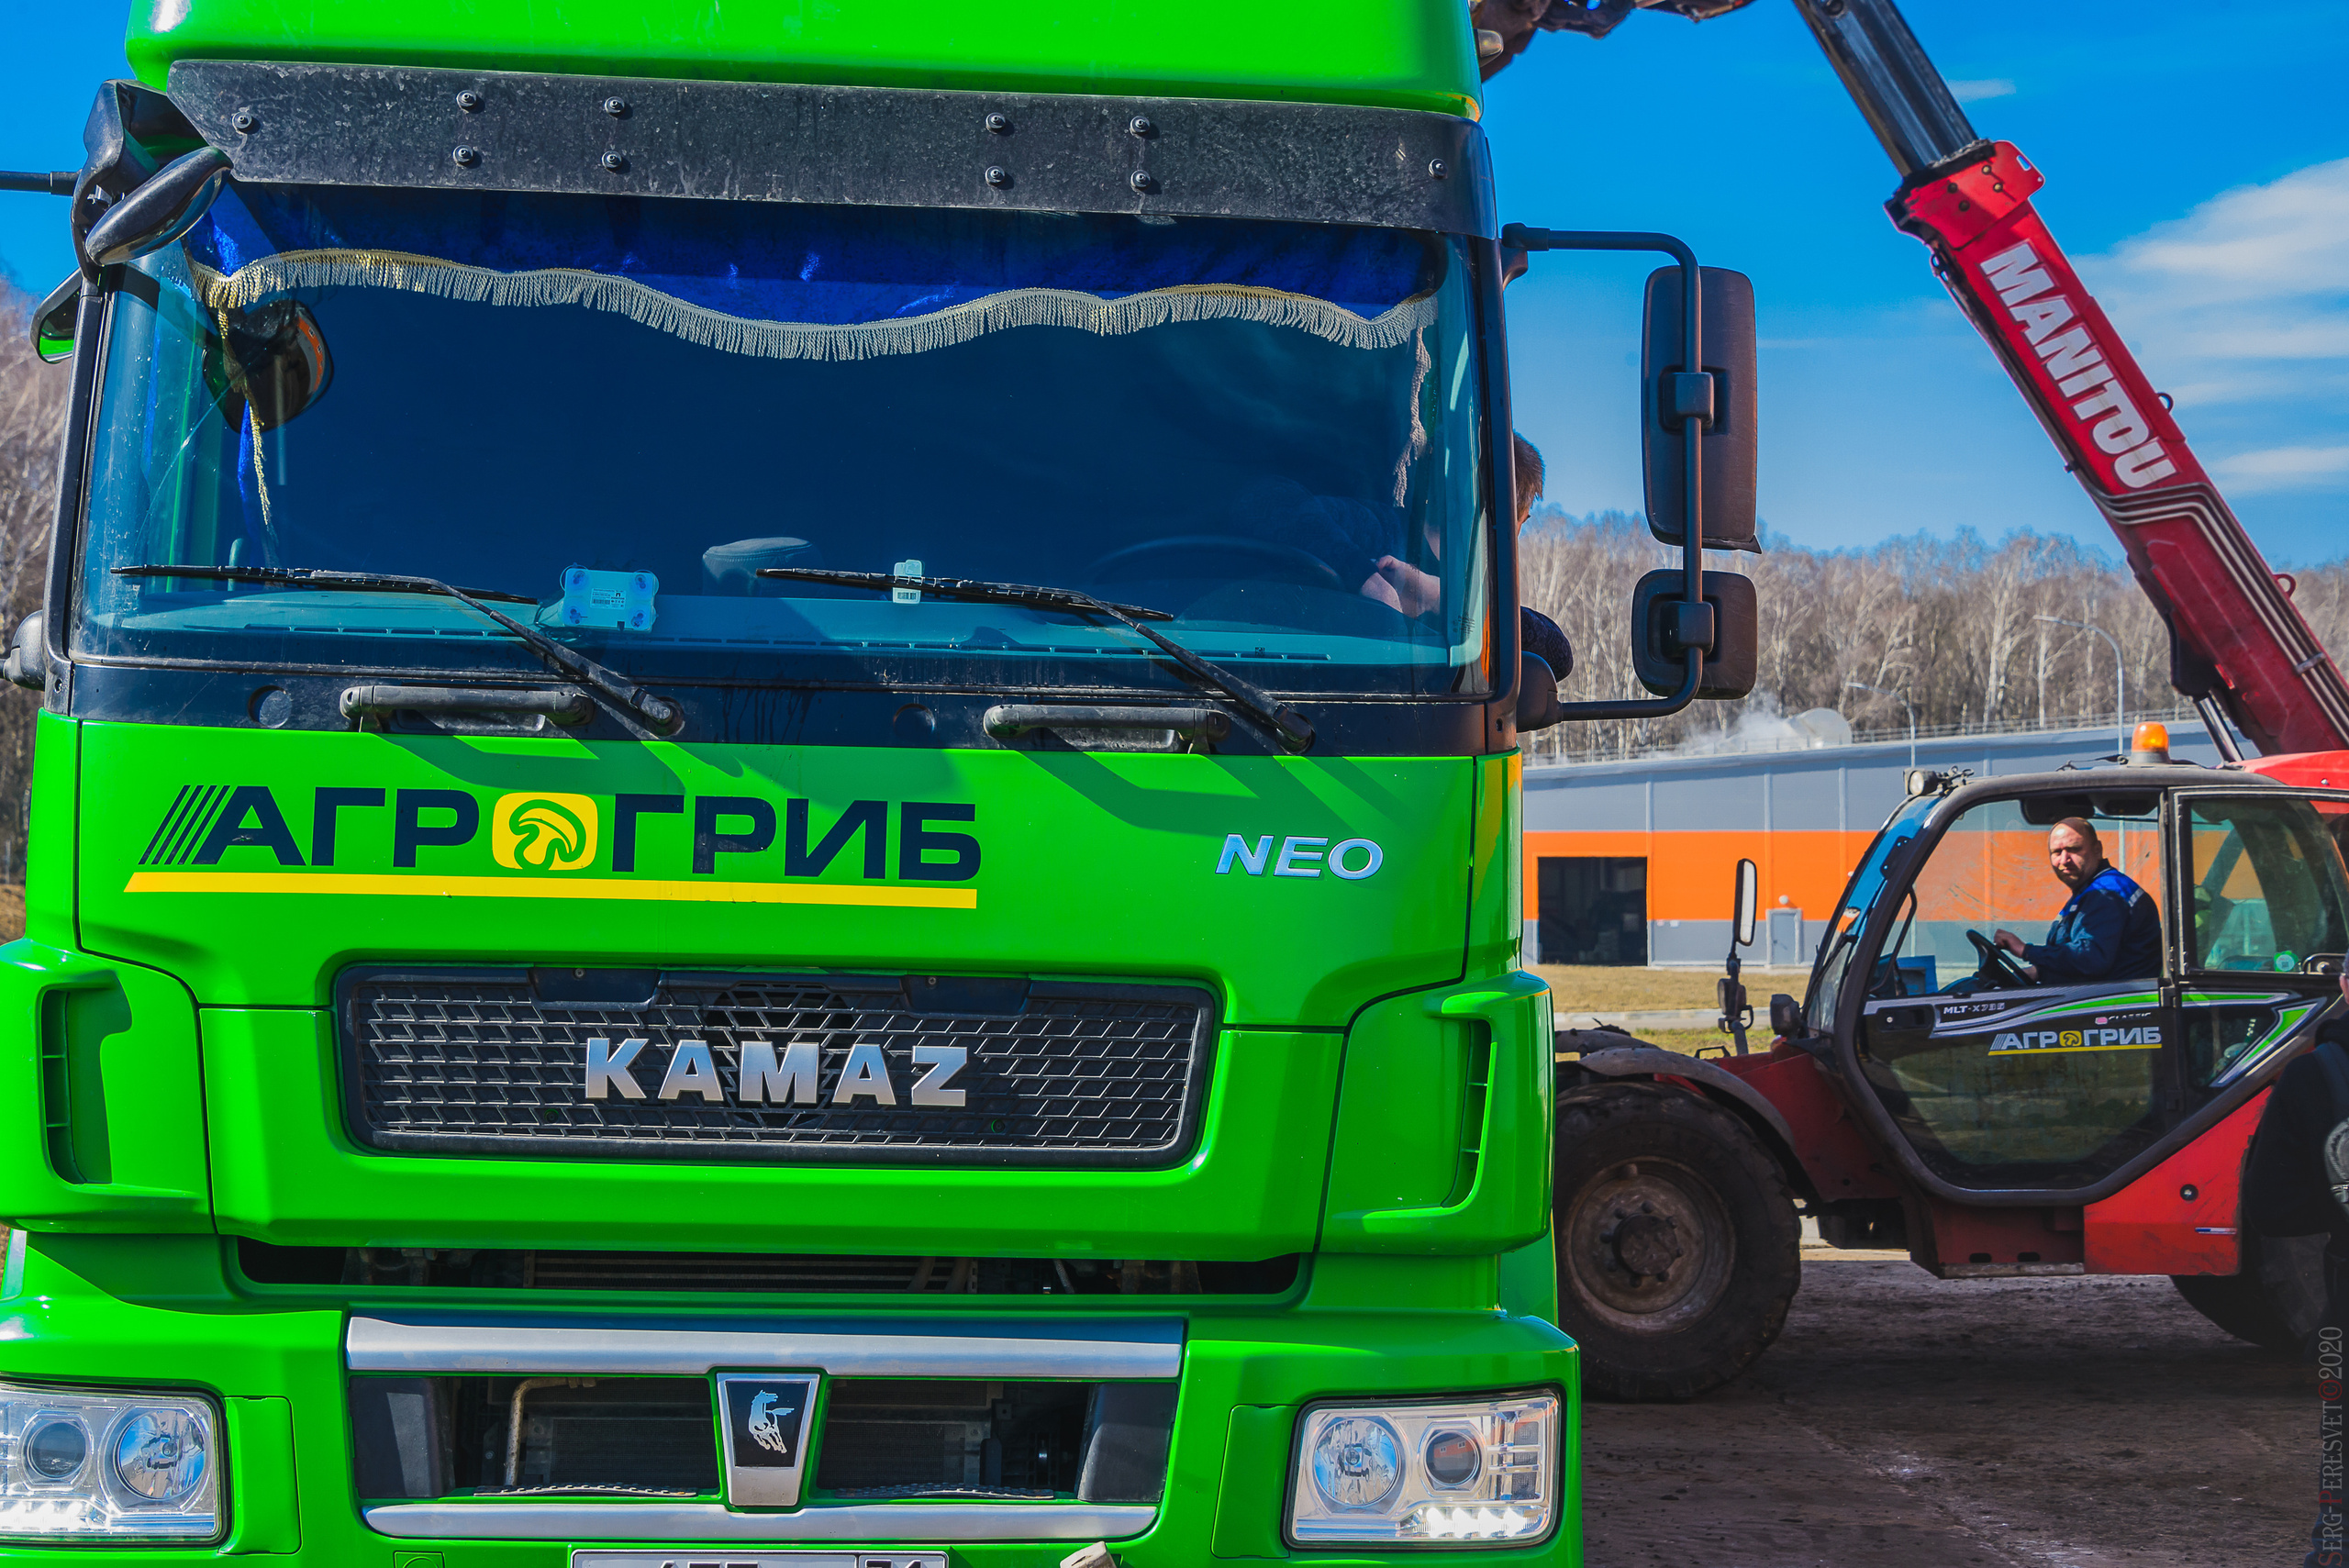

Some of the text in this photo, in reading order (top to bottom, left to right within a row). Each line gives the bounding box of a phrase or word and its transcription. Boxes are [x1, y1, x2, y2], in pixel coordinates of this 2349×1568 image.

[1979, 242, 2177, 488] MANITOU
[1215, 833, 1384, 880] NEO
[584, 1037, 968, 1106] KAMAZ
